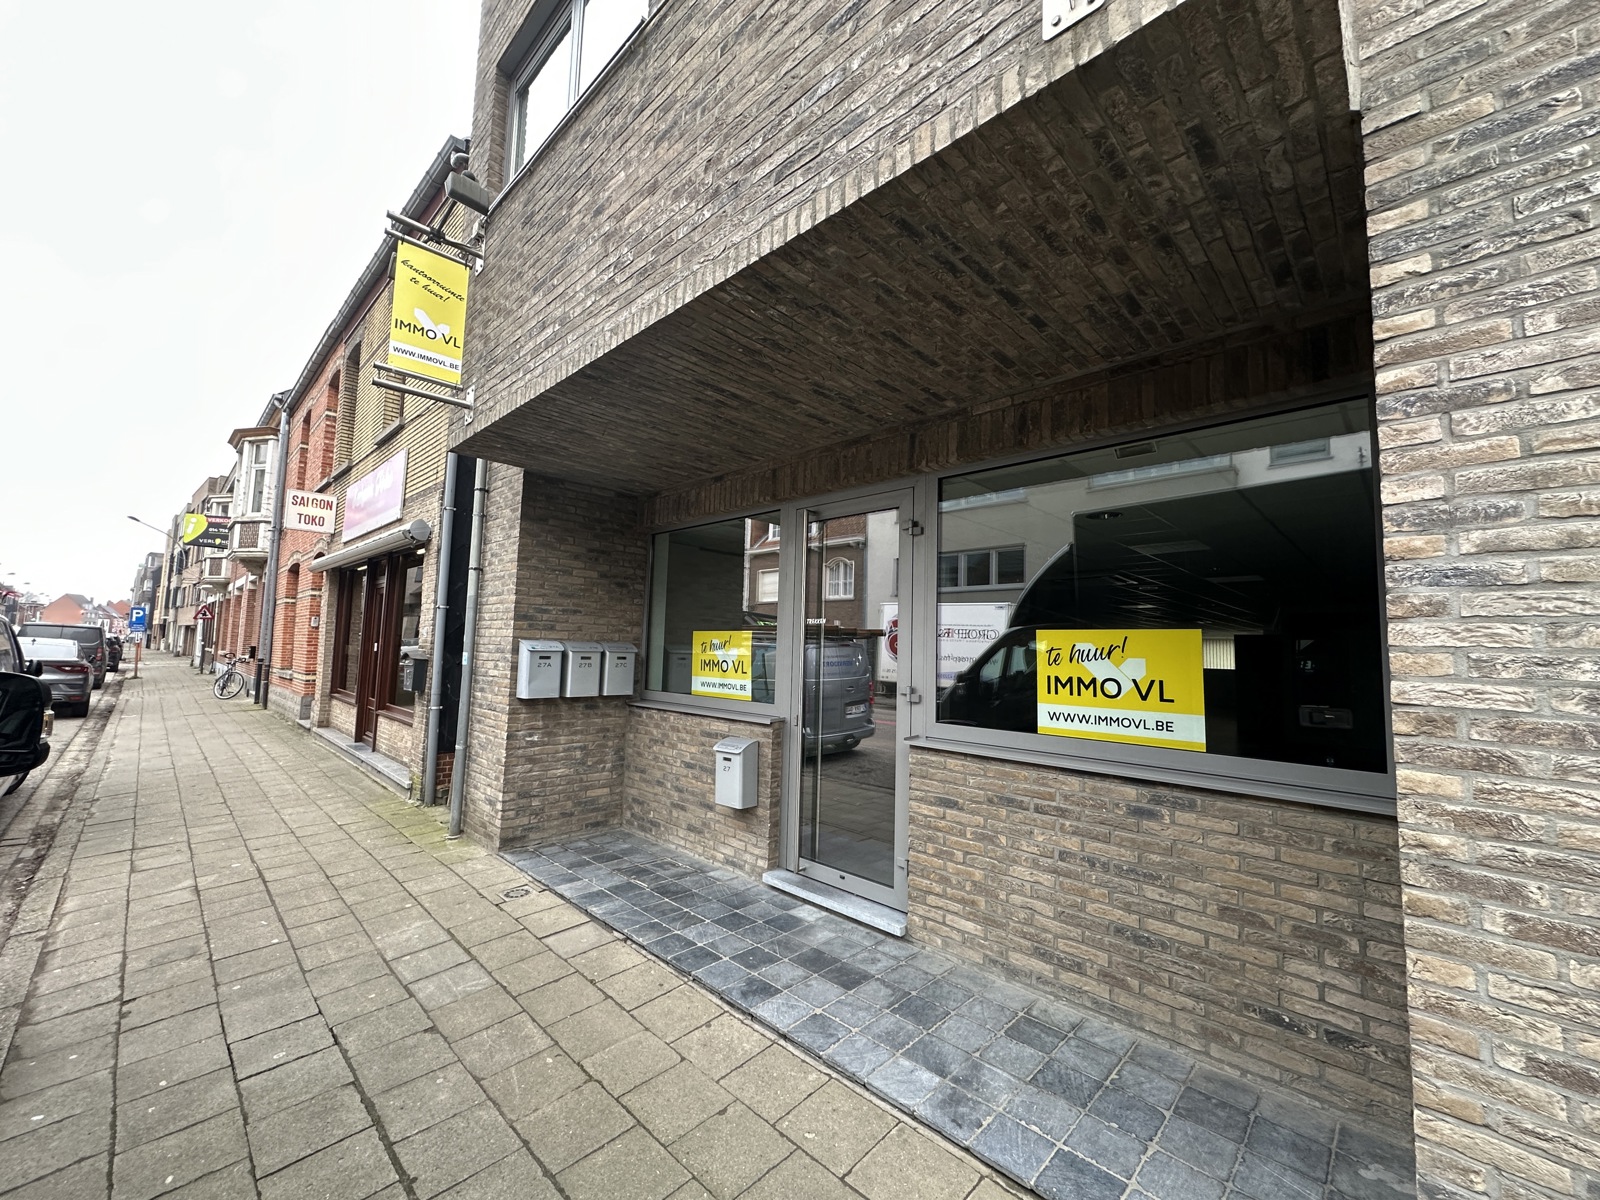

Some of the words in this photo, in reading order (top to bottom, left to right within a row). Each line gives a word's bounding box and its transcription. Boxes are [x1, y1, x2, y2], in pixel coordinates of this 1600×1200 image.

[401, 259, 465, 302] kantoorruimte
[410, 276, 420, 286] te
[421, 283, 450, 303] huur!
[394, 318, 437, 340] IMMO
[441, 334, 461, 349] VL
[393, 346, 460, 371] WWW.IMMOVL.BE
[291, 495, 333, 511] SAIGON
[297, 513, 325, 527] TOKO
[131, 609, 144, 622] P
[700, 641, 707, 654] te
[709, 635, 732, 653] huur!
[1046, 646, 1063, 667] te
[1069, 636, 1129, 664] huur!
[700, 658, 728, 673] IMMO
[731, 660, 748, 675] VL
[700, 680, 747, 692] WWW.IMMOVL.BE
[1046, 675, 1122, 699] IMMO
[1131, 678, 1175, 704] VL
[1047, 710, 1175, 733] WWW.IMMOVL.BE
